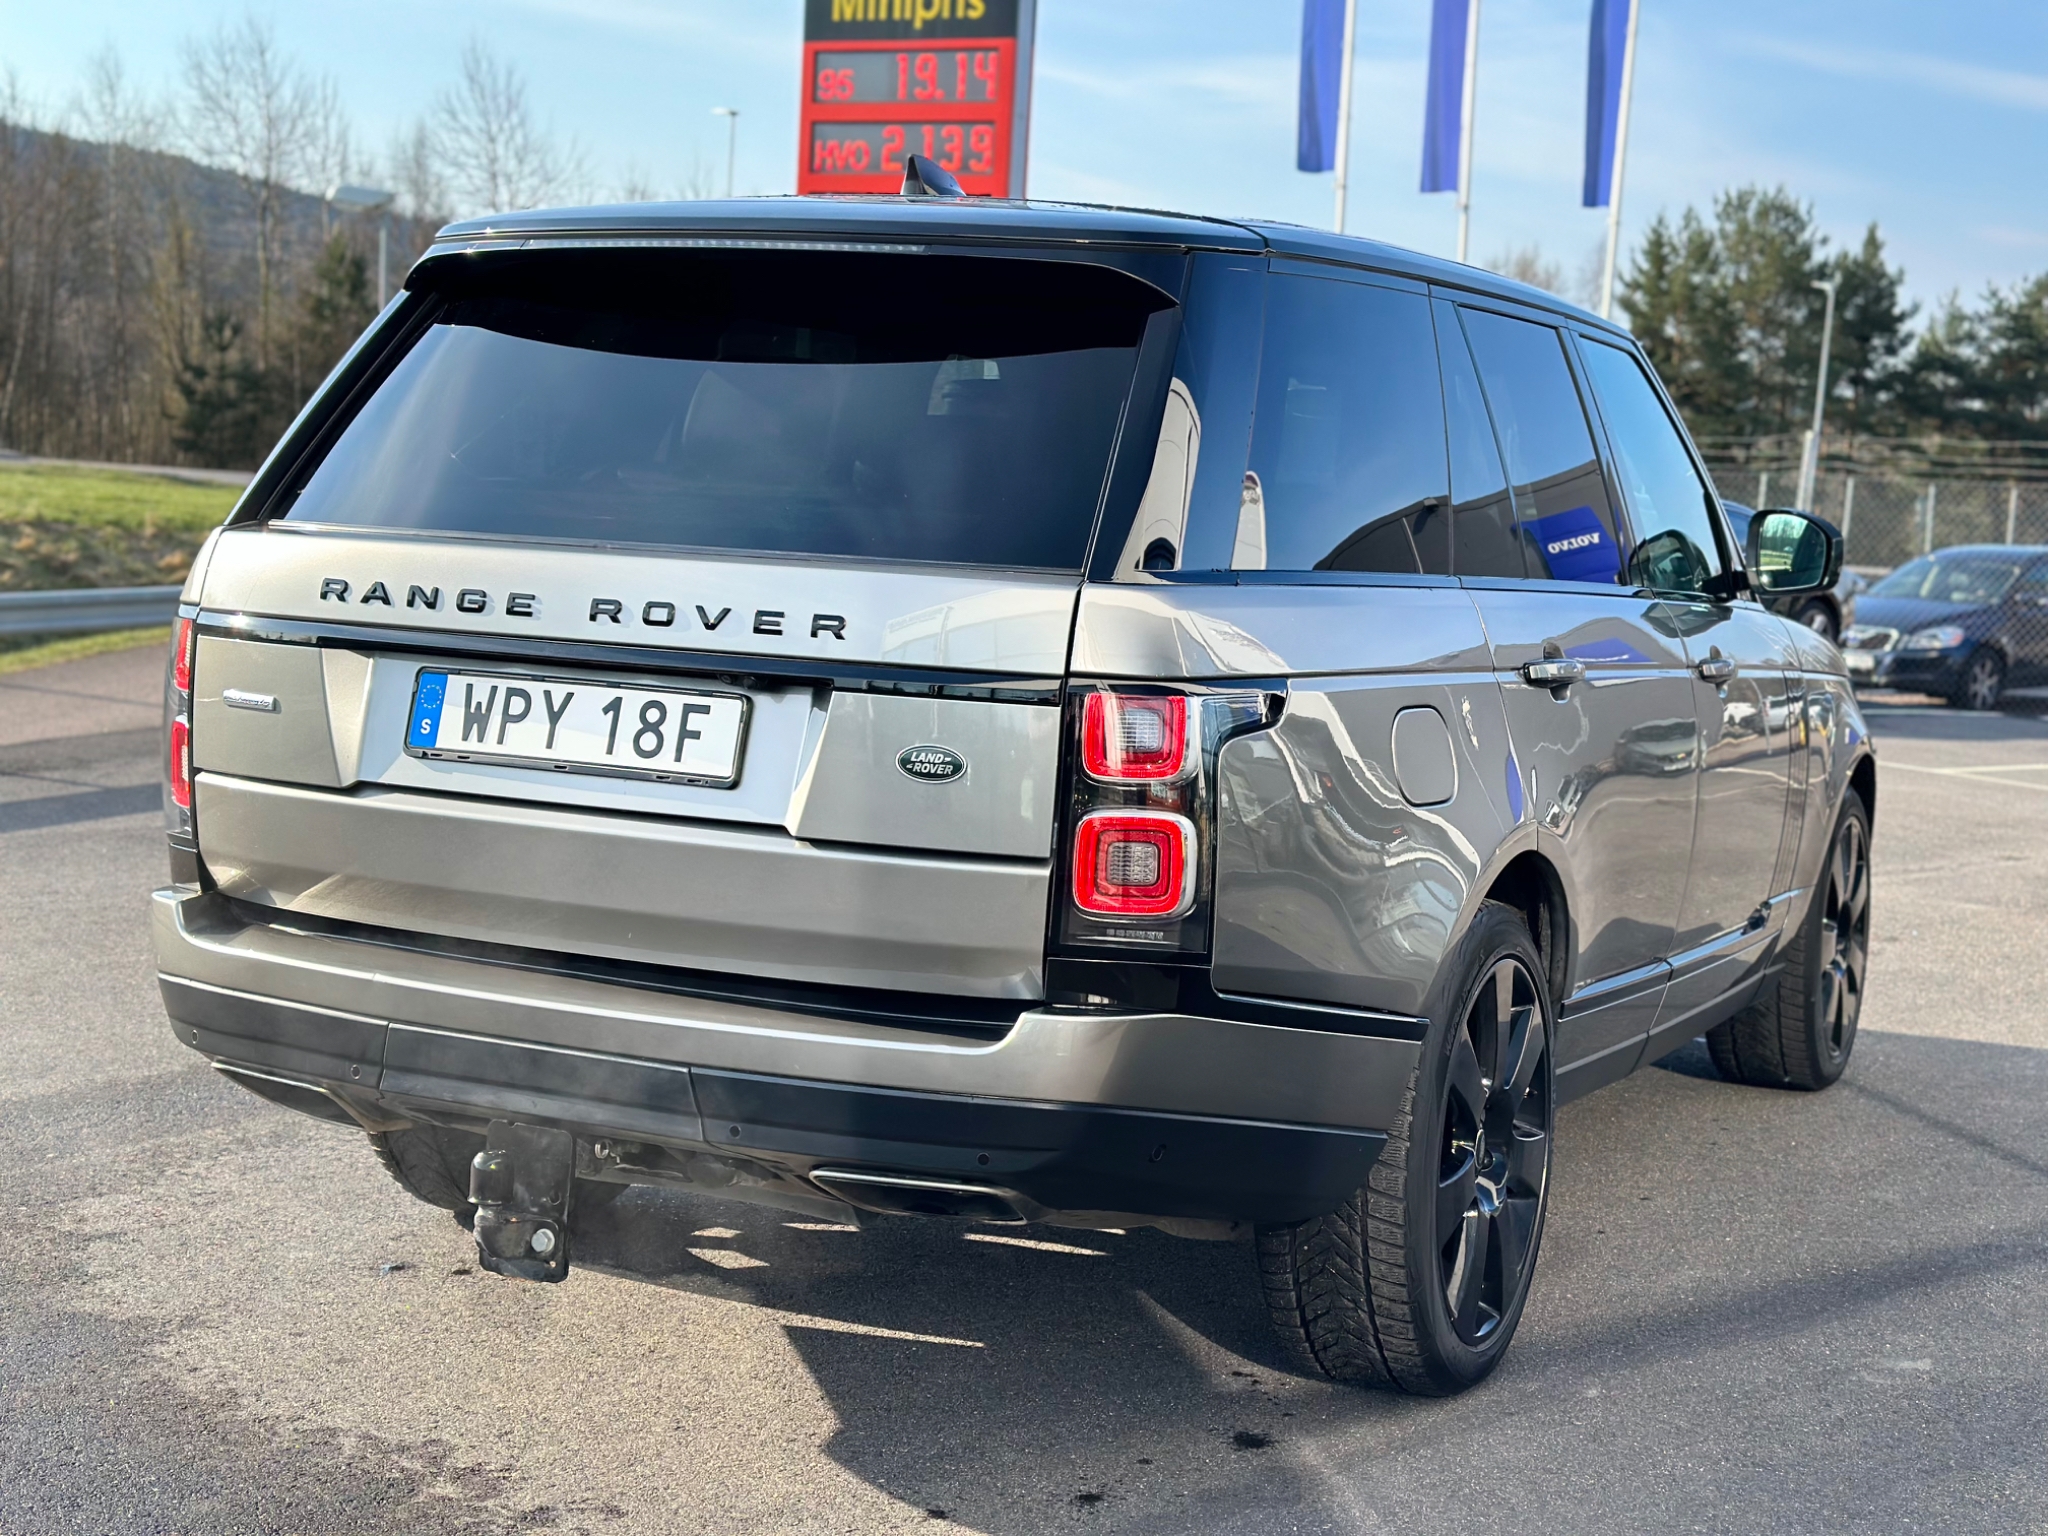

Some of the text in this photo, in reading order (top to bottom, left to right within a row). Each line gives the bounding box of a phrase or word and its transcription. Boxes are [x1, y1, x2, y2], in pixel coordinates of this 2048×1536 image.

[896, 52, 999, 100] 19.14
[813, 139, 871, 171] HVO
[319, 577, 536, 618] RANGE
[588, 597, 847, 641] ROVER
[420, 717, 432, 735] S
[461, 683, 711, 763] WPY 18F
[912, 762, 954, 775] ROVER
